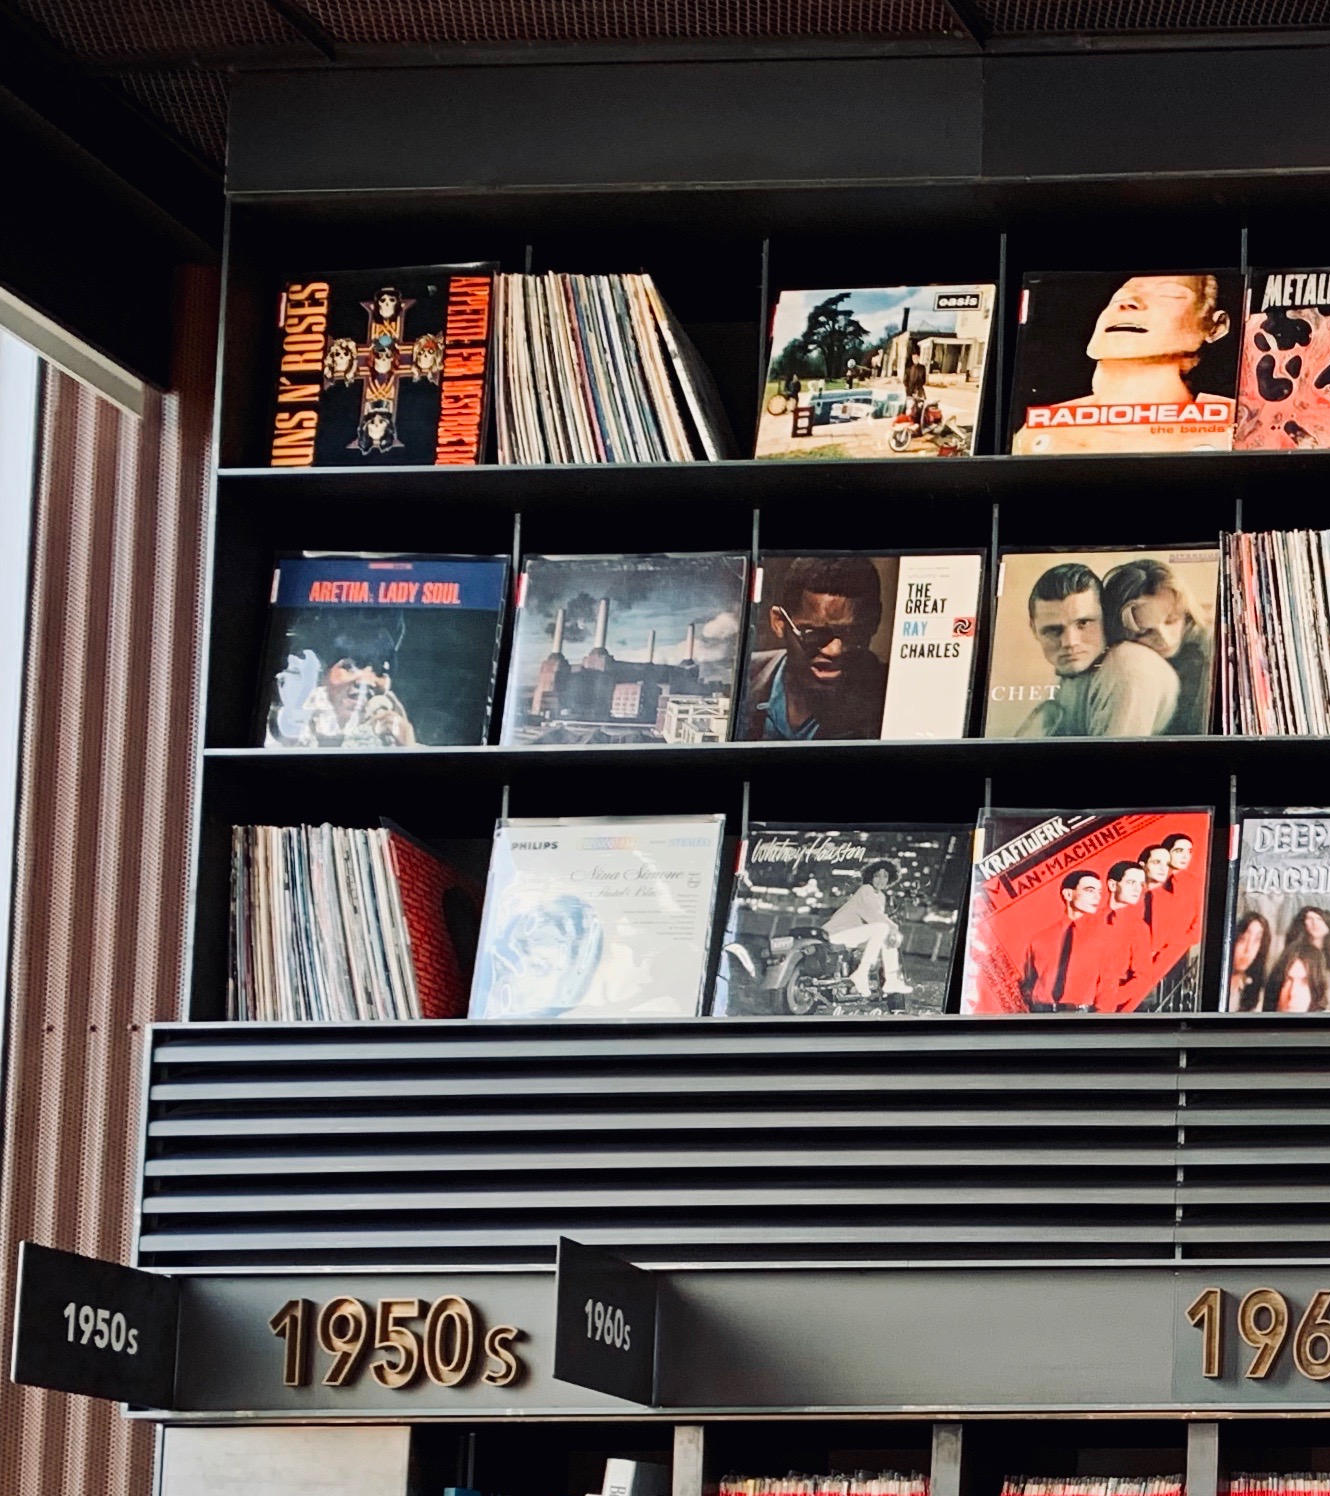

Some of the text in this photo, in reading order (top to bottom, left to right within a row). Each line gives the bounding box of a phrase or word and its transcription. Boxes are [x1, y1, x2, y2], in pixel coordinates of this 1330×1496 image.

[938, 295, 978, 308] oasis
[1028, 404, 1229, 426] RADIOHEAD
[1150, 425, 1225, 434] the bends
[907, 583, 932, 599] THE
[905, 598, 947, 615] GREAT
[903, 621, 928, 636] RAY
[900, 643, 960, 659] CHARLES
[991, 684, 1062, 702] CHET
[510, 841, 558, 851] PHILIPS
[979, 817, 1068, 881] KRAFTWERK
[570, 866, 685, 881] Nina Simone
[62, 1301, 139, 1356] 1950s
[584, 1298, 631, 1352] 1960s
[268, 1294, 519, 1388] 1950s
